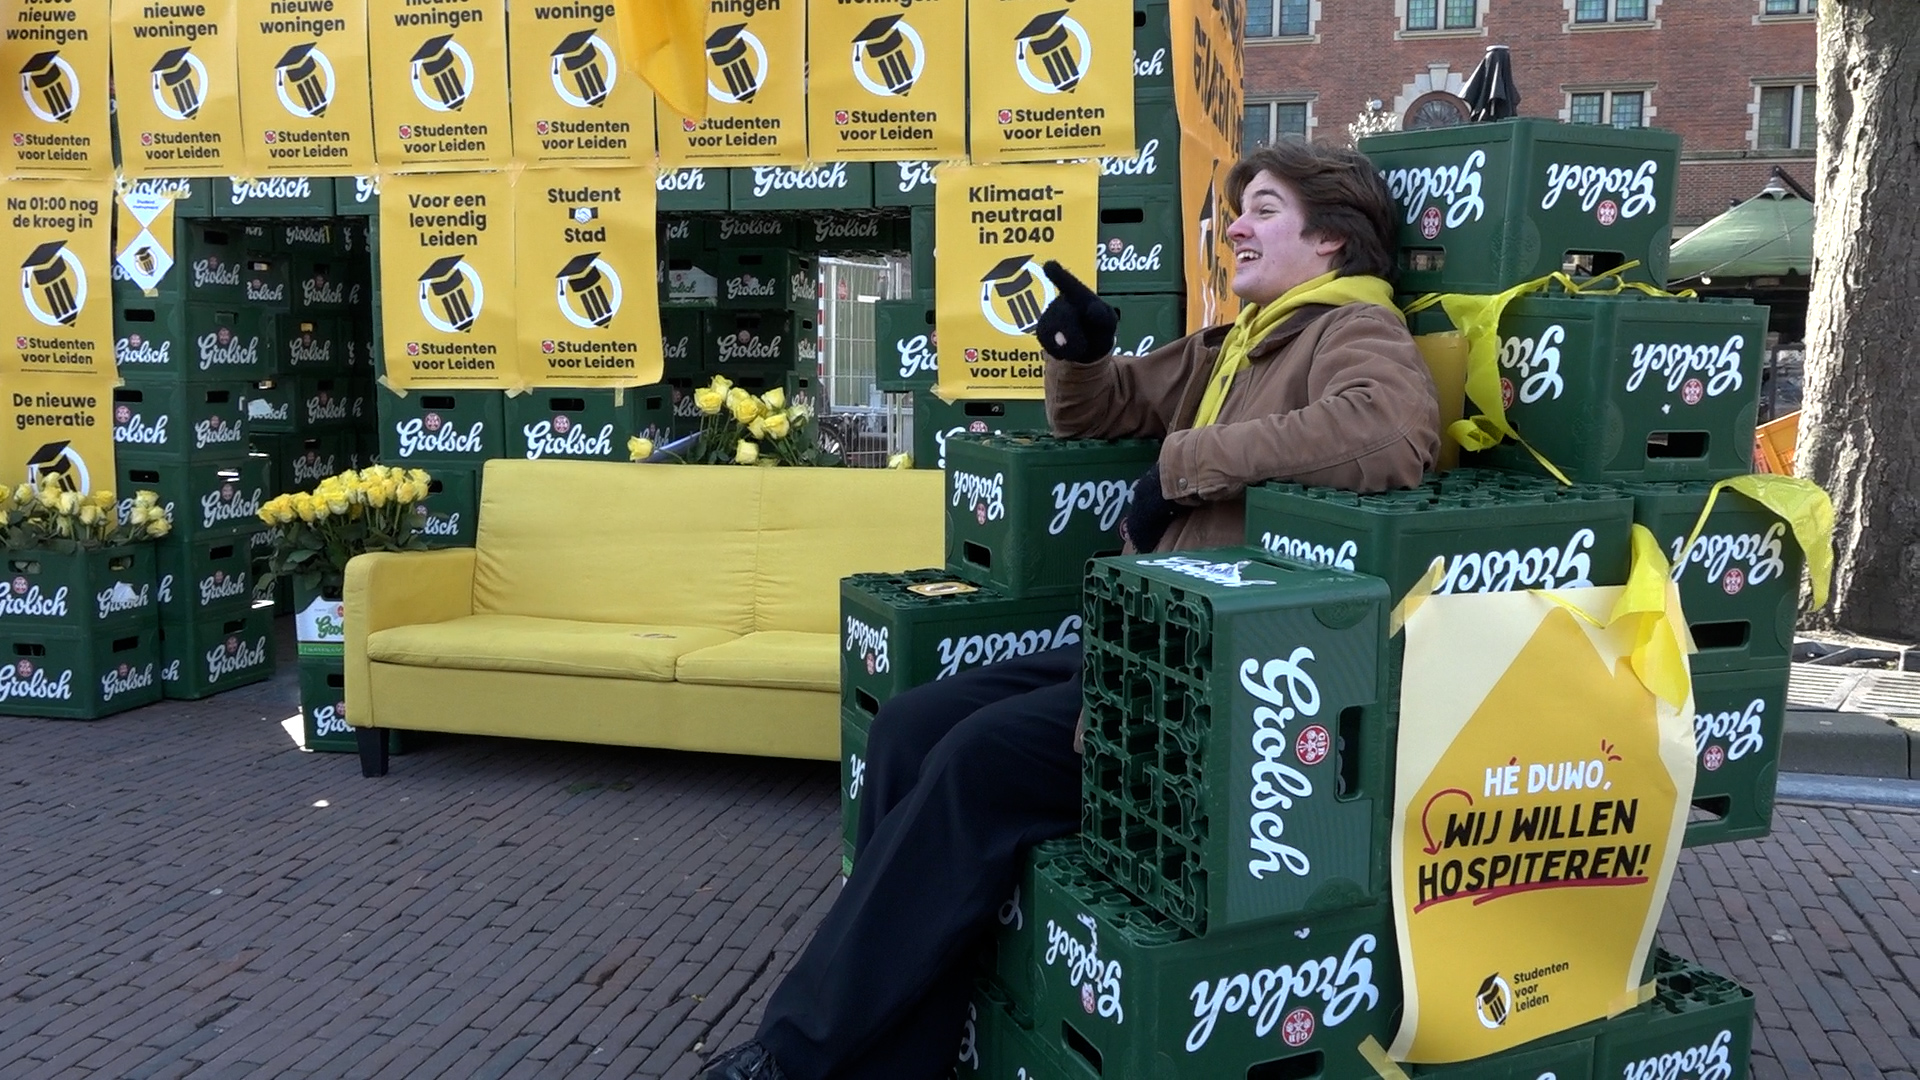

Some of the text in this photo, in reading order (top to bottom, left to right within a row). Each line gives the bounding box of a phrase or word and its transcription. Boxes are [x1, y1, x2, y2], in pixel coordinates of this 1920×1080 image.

[18, 7, 76, 22] nieuwe
[144, 2, 205, 18] nieuwe
[271, 0, 334, 14] nieuwe
[535, 0, 615, 22] woninge
[711, 0, 780, 17] ningen
[260, 16, 345, 37] woningen
[395, 8, 483, 28] woningen
[6, 25, 88, 45] woningen
[133, 21, 218, 41] woningen
[852, 109, 937, 125] Studenten
[1016, 106, 1105, 122] Studenten
[413, 123, 488, 138] Studenten
[551, 120, 630, 135] Studenten
[840, 124, 933, 141] voor Leiden
[1003, 123, 1101, 140] voor Leiden
[25, 134, 91, 148] Studenten
[154, 131, 221, 145] Studenten
[278, 130, 350, 145] Studenten
[404, 138, 486, 154] voor Leiden
[542, 135, 627, 150] voor Leiden
[688, 132, 778, 148] voor Leiden
[18, 147, 88, 161] voor Leiden
[145, 145, 220, 161] voor Leiden
[270, 144, 348, 159] voor Leiden
[548, 187, 621, 203] Student
[969, 185, 1064, 203] Klimaat-
[1380, 149, 1486, 229] Grolsc
[1541, 159, 1658, 219] Grolsch
[7, 197, 98, 215] Na 01:00 nog
[408, 194, 486, 209] Voor een
[13, 214, 93, 232] de kroeg in
[409, 212, 487, 231] levendig
[971, 206, 1062, 223] neutraal
[564, 227, 606, 243] Stad
[814, 216, 879, 242] Grolsch
[979, 226, 1055, 244] in 2040
[421, 231, 478, 247] Leiden
[193, 257, 241, 288] Grolsch
[302, 279, 343, 306] Grolsch
[29, 339, 95, 350] Studenten
[115, 340, 170, 367] Grolsch
[198, 336, 258, 371] Grolsch
[289, 338, 331, 366] Grolsch
[421, 343, 497, 355] Studenten
[557, 341, 638, 354] Studenten
[717, 334, 781, 363] Grolsch
[21, 352, 93, 365] voor Leiden
[412, 357, 495, 370] voor Leiden
[548, 356, 635, 369] voor Leiden
[1626, 334, 1744, 398] Grolsch
[970, 364, 1045, 379] voor Leid
[13, 392, 97, 408] De nieuwe
[307, 397, 347, 424] Grolsch
[16, 411, 95, 429] generatie
[195, 419, 242, 449] Grolsch
[397, 418, 484, 458] Grolsch
[523, 421, 614, 460] Grolsch
[293, 454, 335, 484] Grolsch
[953, 470, 1005, 521] Grolsch
[202, 489, 262, 528] Grolsch
[1669, 520, 1788, 587] Grolsch
[200, 572, 246, 606] Grolsch
[846, 614, 890, 674] Grolsch
[206, 636, 266, 684] Grolsch
[0, 659, 72, 699] Grolsch
[102, 662, 153, 701] Grolsch
[1240, 646, 1321, 880] Grolsch
[1484, 756, 1612, 798] HÉ DUWO,
[1443, 798, 1638, 849] WIJ WILLEN
[1418, 844, 1652, 904] HOSPITEREN!
[1514, 962, 1569, 984] Studenten
[1185, 933, 1379, 1053] Grolsch
[1515, 984, 1538, 998] voor
[1516, 993, 1549, 1013] Leiden
